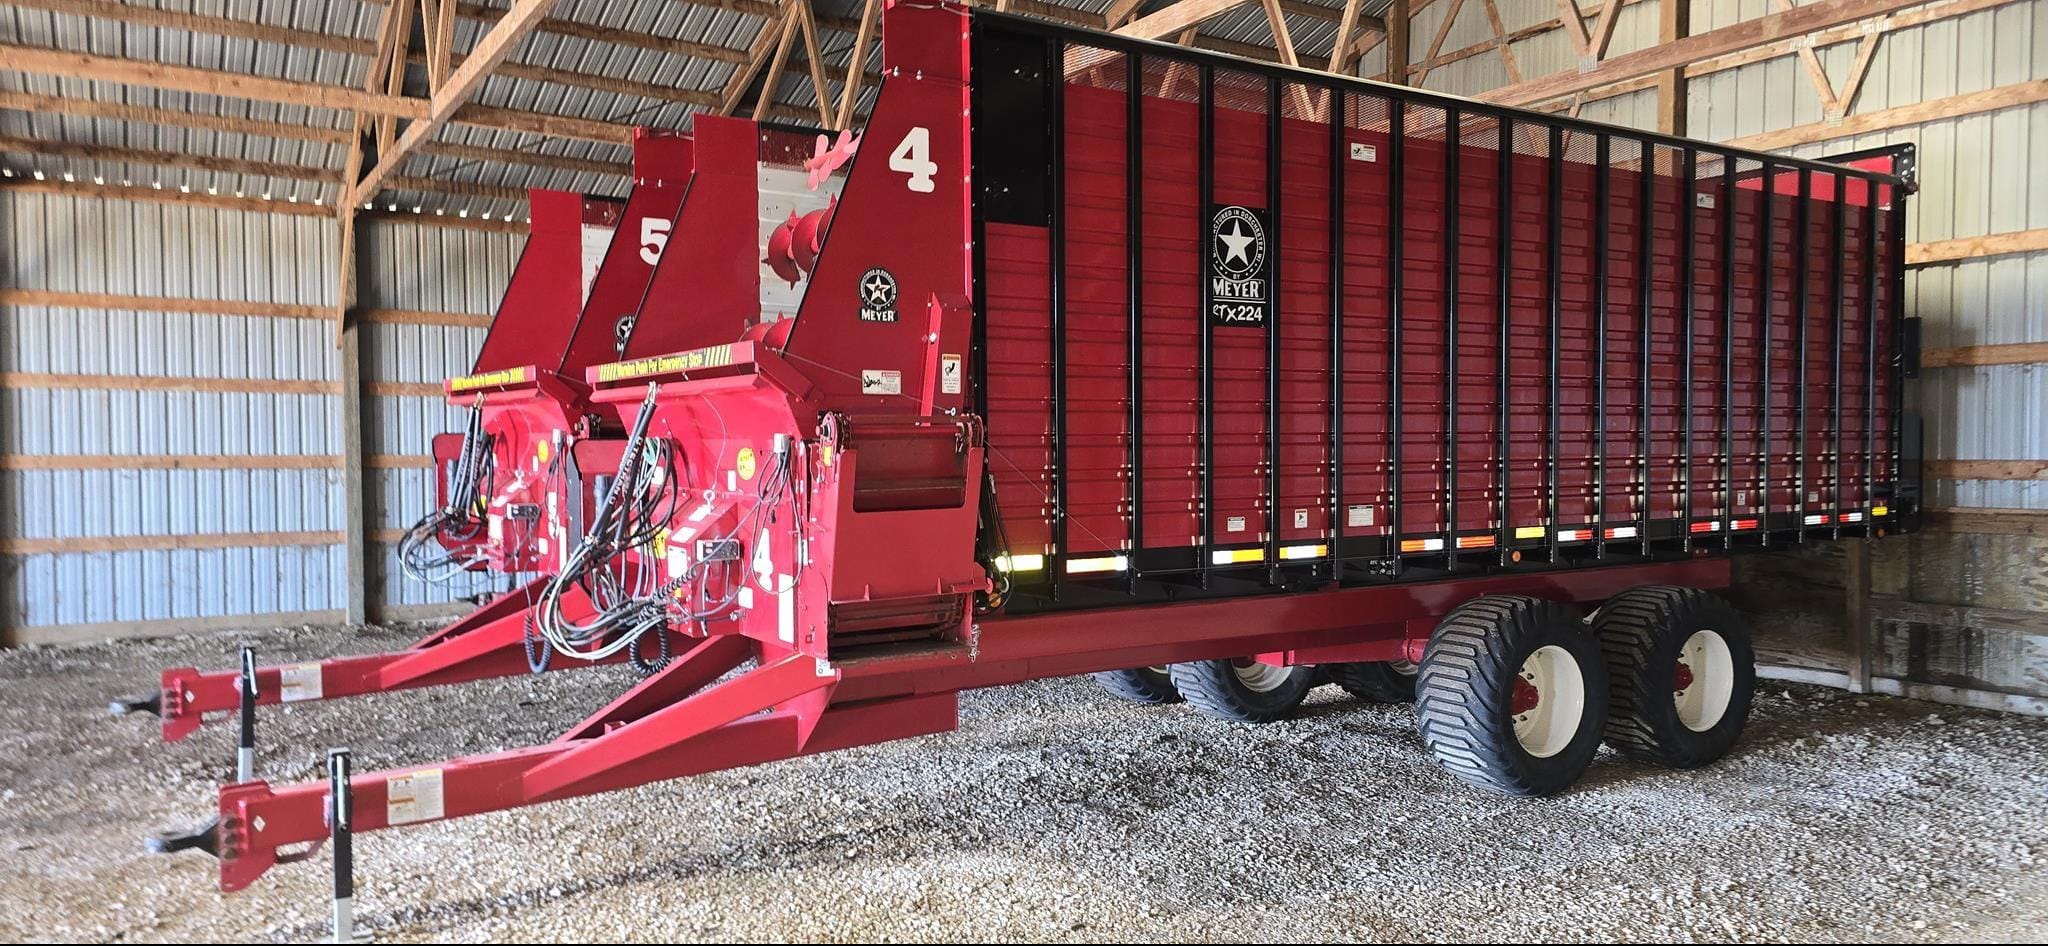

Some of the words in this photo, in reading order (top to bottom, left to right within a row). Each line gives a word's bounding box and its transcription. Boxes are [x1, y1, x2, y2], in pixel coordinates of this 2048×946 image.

[889, 126, 938, 193] 4
[640, 216, 671, 266] 5
[1213, 278, 1259, 298] MEYER
[861, 308, 894, 322] MEYER
